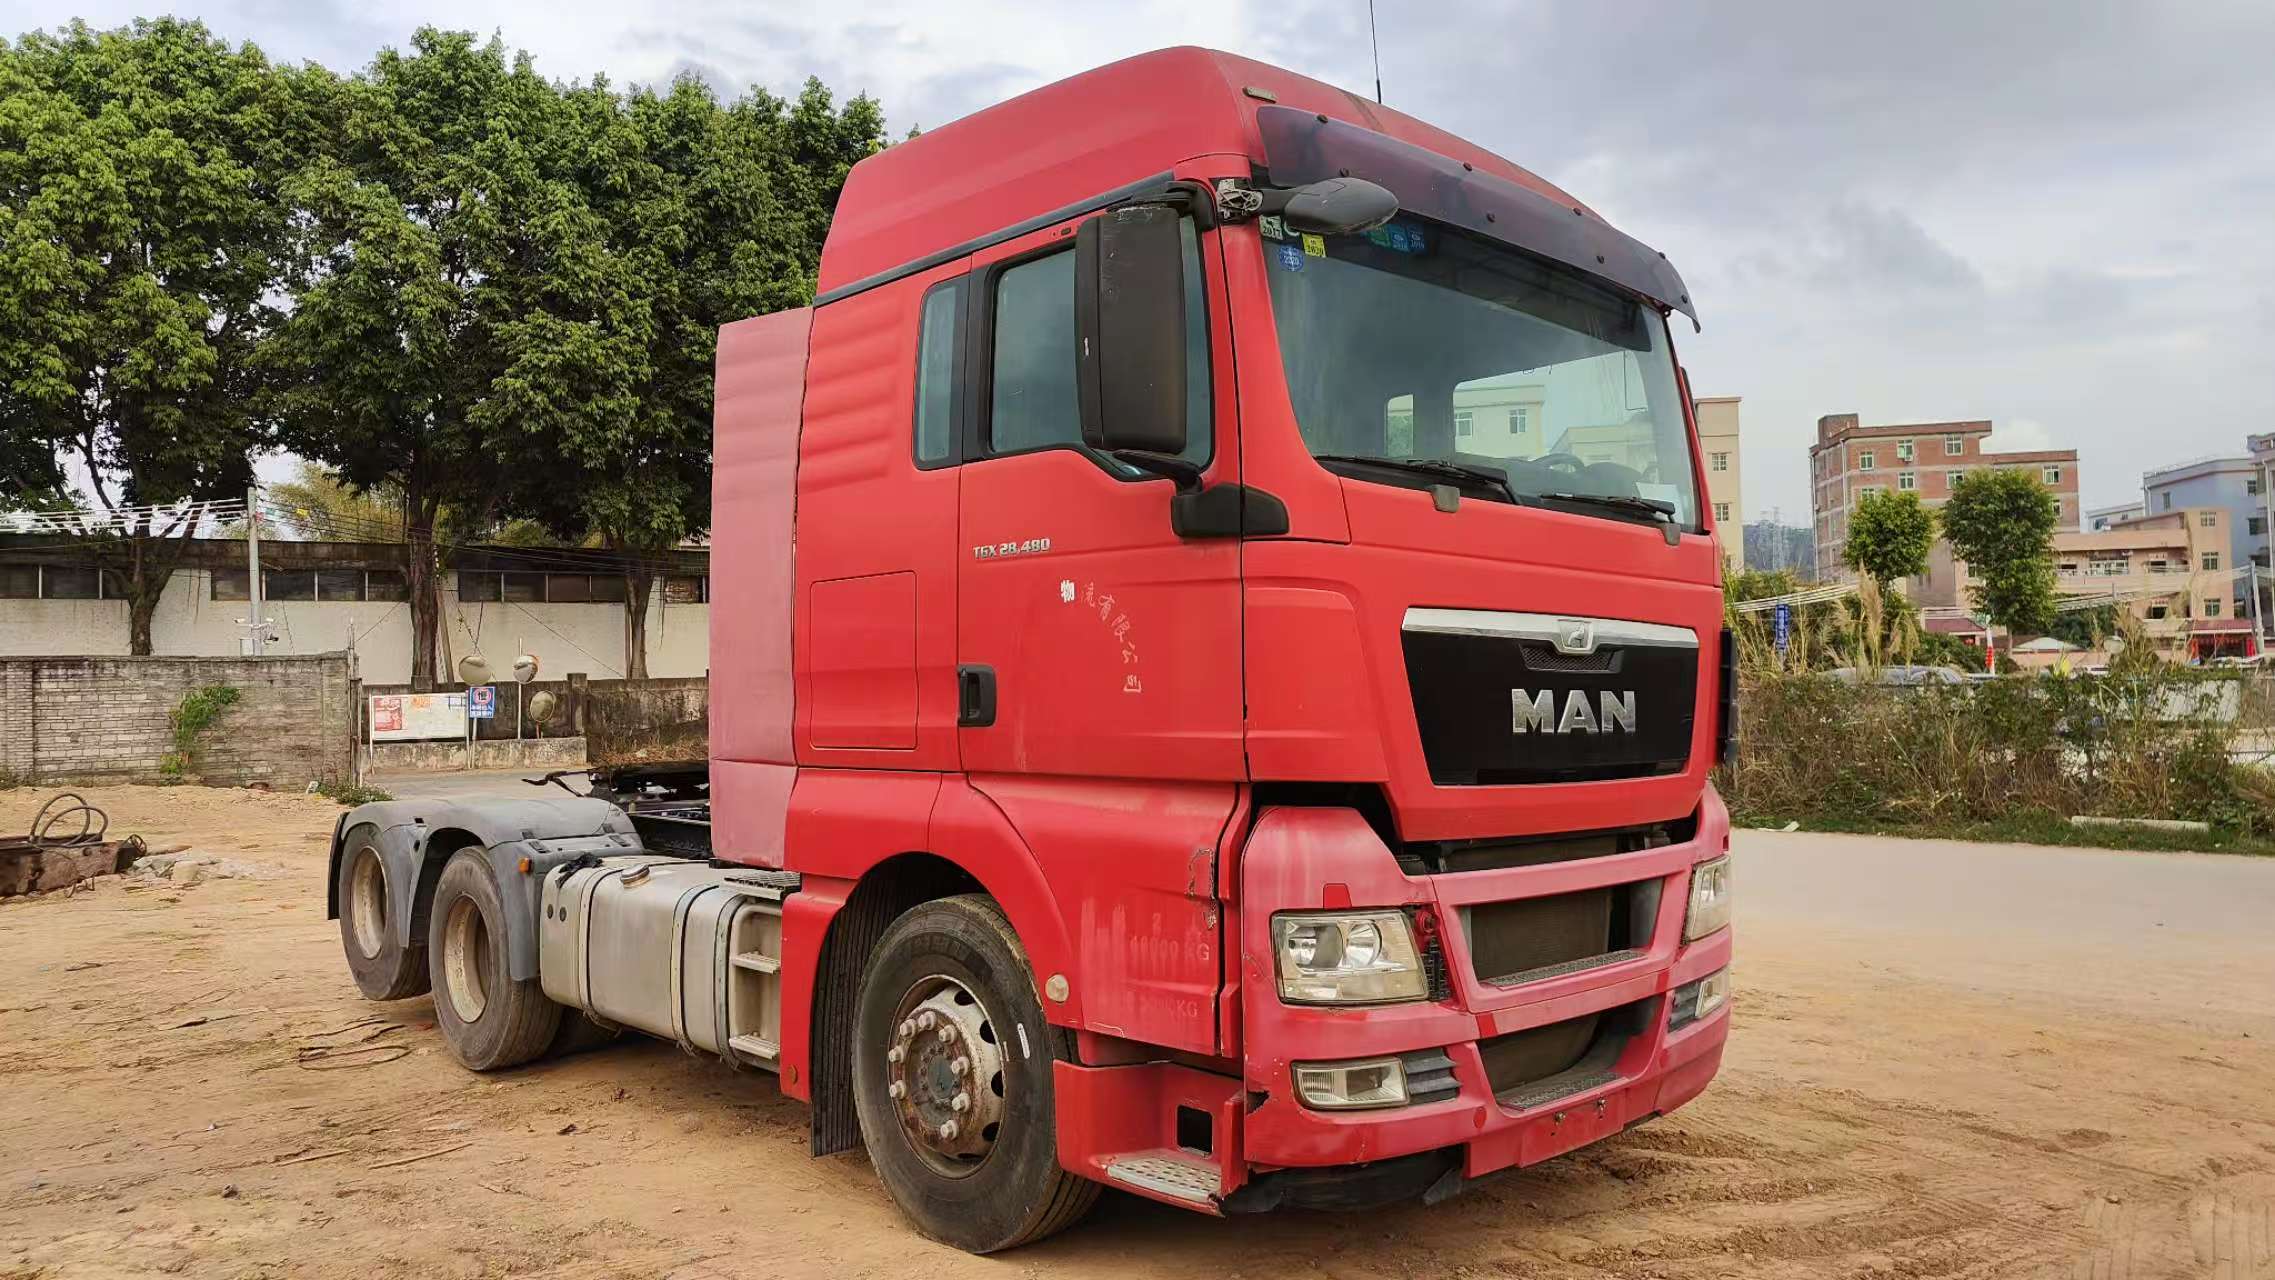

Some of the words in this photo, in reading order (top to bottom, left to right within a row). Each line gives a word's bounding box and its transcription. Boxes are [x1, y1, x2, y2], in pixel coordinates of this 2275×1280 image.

[973, 546, 997, 560] TGX
[999, 538, 1051, 557] 28.480
[1512, 688, 1637, 734] MAN
